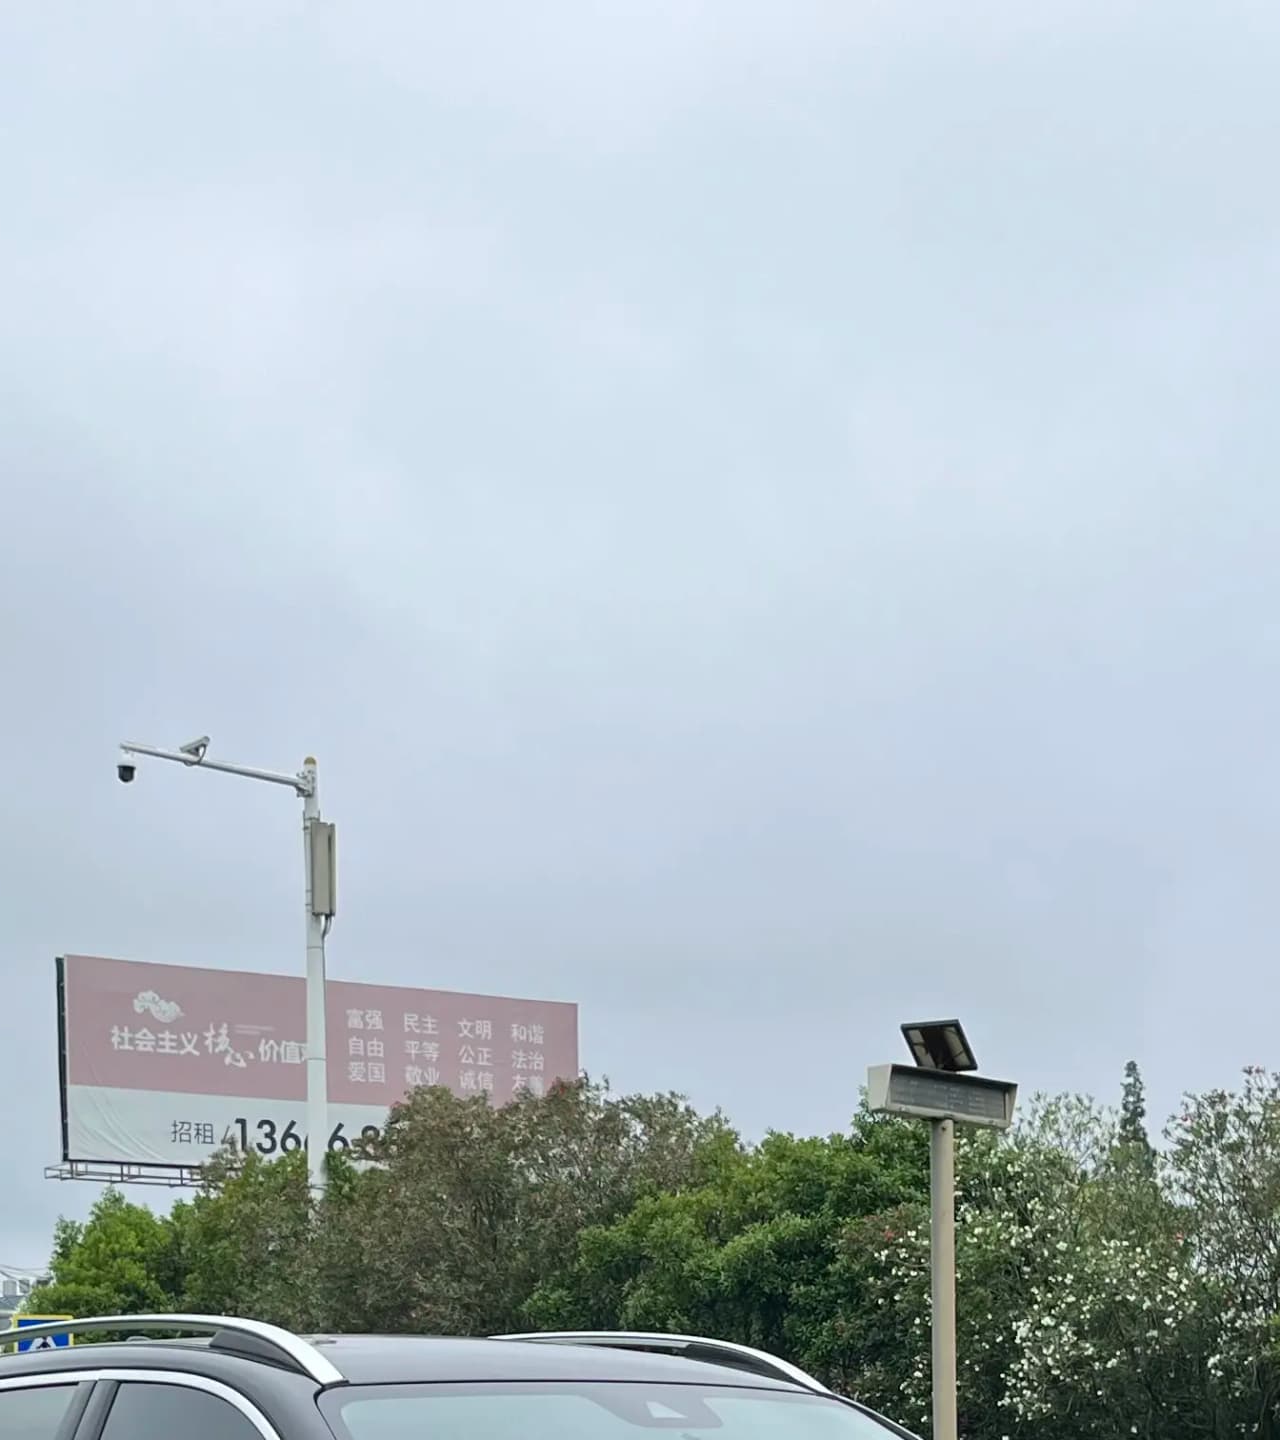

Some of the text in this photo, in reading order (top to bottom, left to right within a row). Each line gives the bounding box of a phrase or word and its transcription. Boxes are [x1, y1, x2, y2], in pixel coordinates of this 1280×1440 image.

[346, 1009, 544, 1045] 富强 民主 文明 和谐
[348, 1037, 544, 1071] 自由 平等 公正 法治
[348, 1061, 385, 1083] 爱国
[406, 1066, 440, 1086] 敬业
[460, 1071, 494, 1091] 诚信
[171, 1120, 215, 1145] 招租
